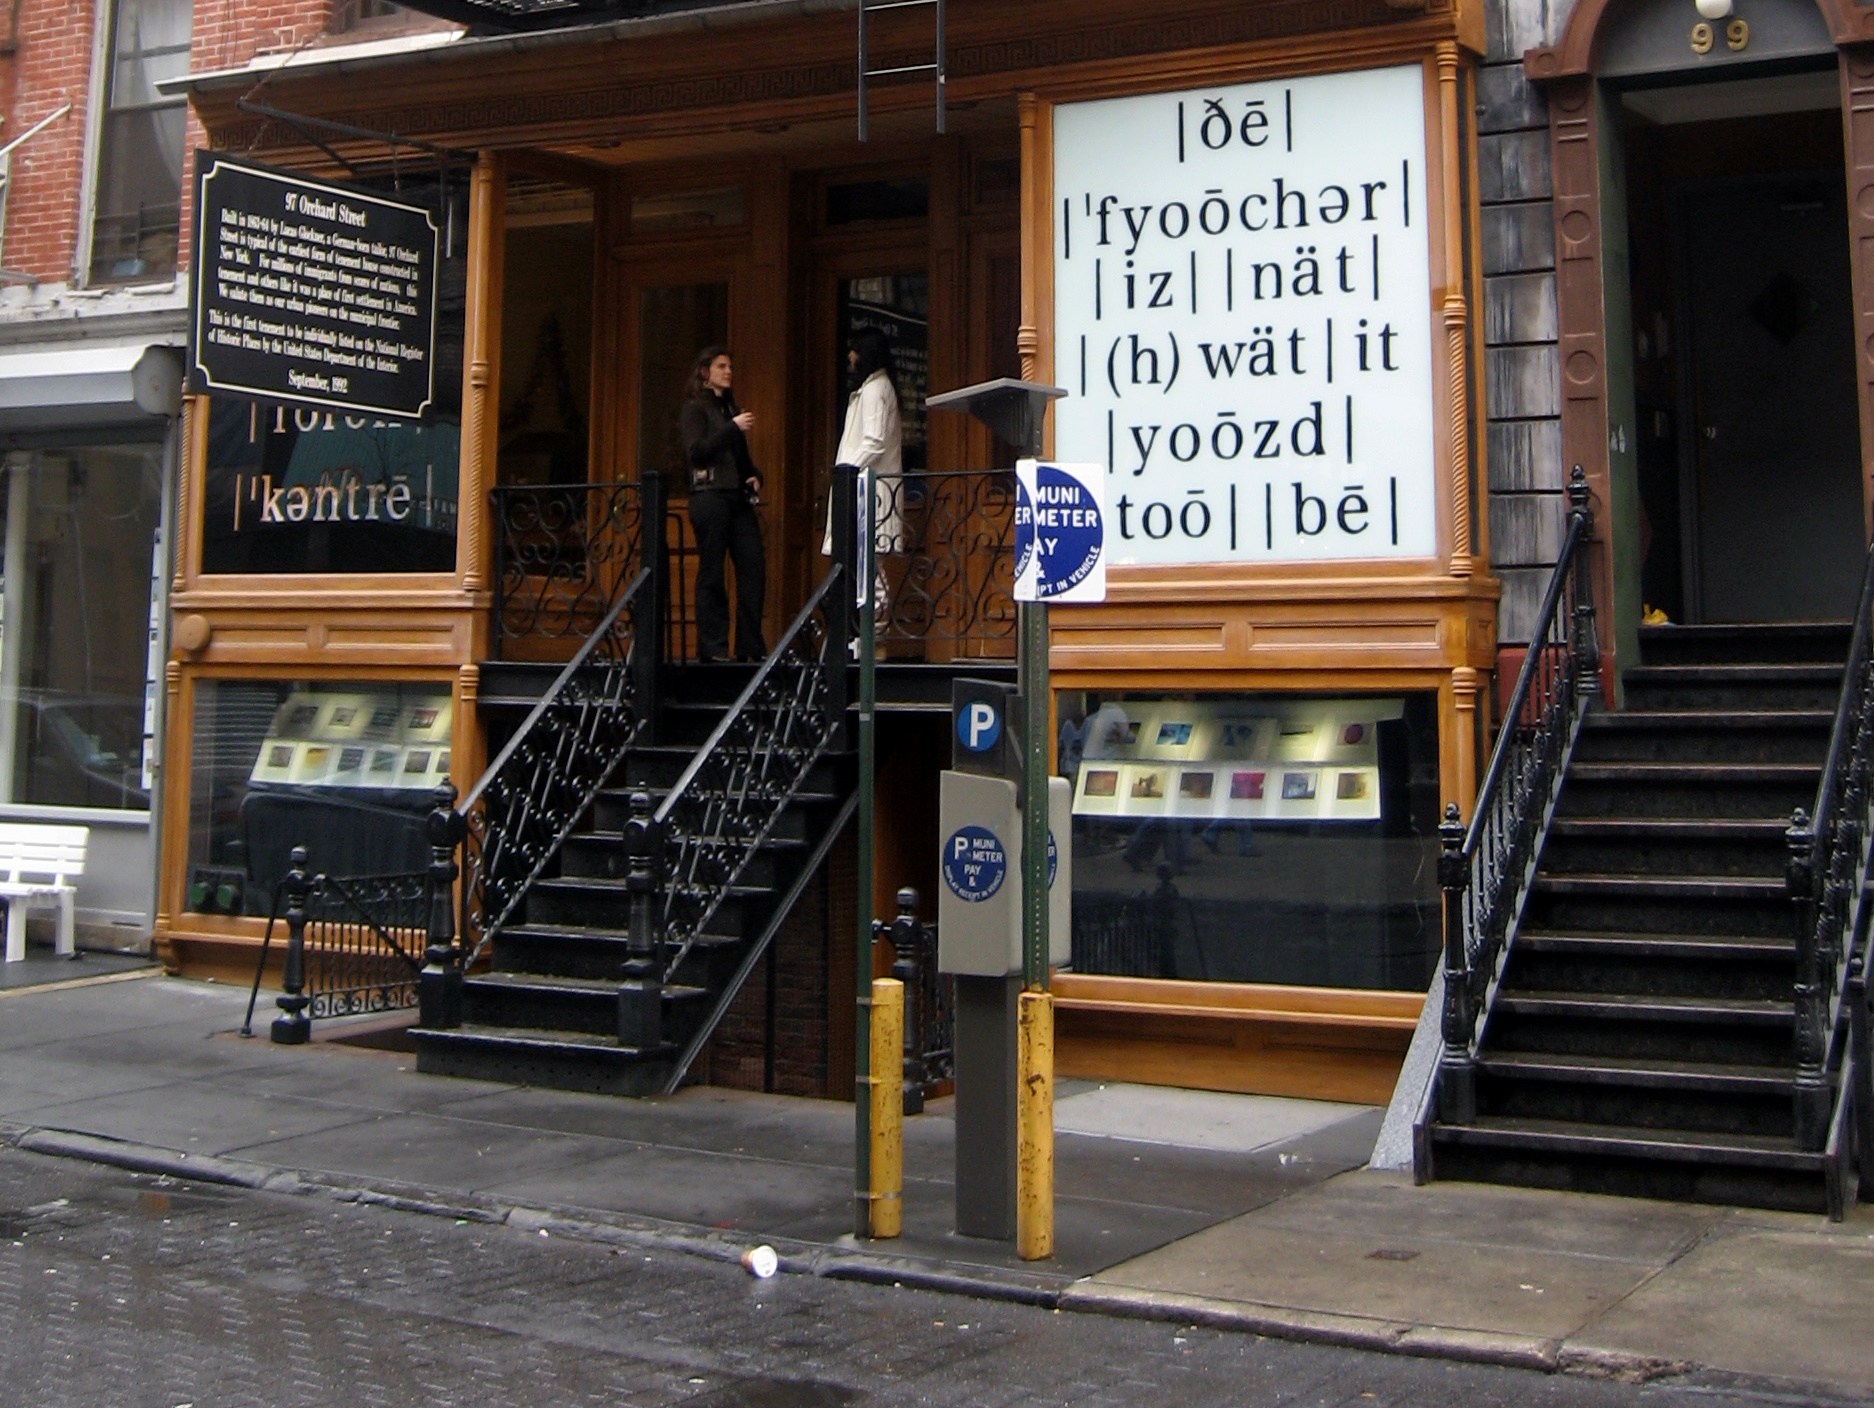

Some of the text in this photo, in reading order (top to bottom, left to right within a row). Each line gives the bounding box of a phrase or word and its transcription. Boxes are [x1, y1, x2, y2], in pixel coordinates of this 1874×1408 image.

[285, 192, 366, 228] 97 Orchard Street
[1036, 486, 1080, 504] MUNI
[1036, 509, 1097, 528] METER
[1036, 538, 1058, 556] AY
[1057, 580, 1068, 592] IN
[1069, 545, 1100, 583] VEHICLE
[970, 704, 995, 747] P
[954, 836, 996, 860] P MUNI
[972, 851, 1003, 863] METER
[964, 864, 982, 875] PAY
